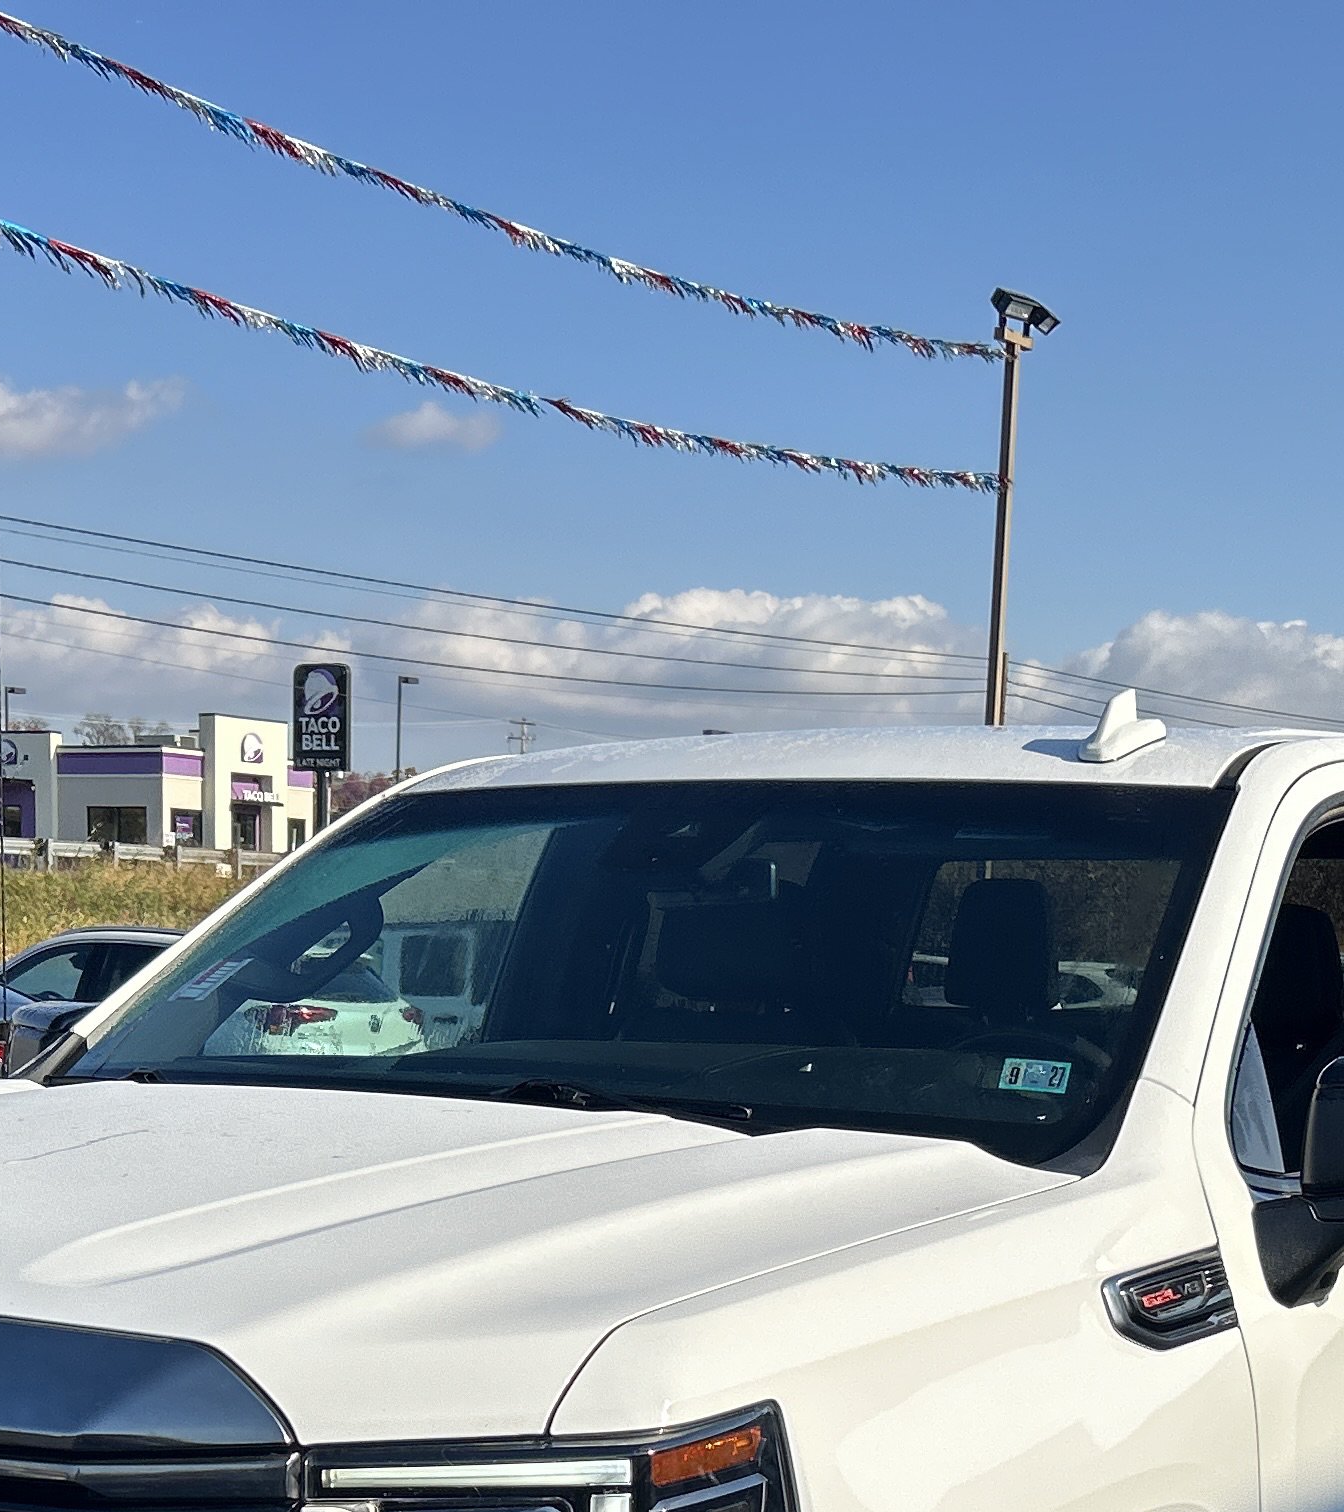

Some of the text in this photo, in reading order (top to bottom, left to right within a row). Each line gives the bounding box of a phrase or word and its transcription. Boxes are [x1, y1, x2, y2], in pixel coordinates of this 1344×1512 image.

[299, 716, 340, 734] TACO
[301, 735, 340, 751] BELL
[242, 789, 264, 802] TACO
[1008, 1065, 1066, 1088] 9 27
